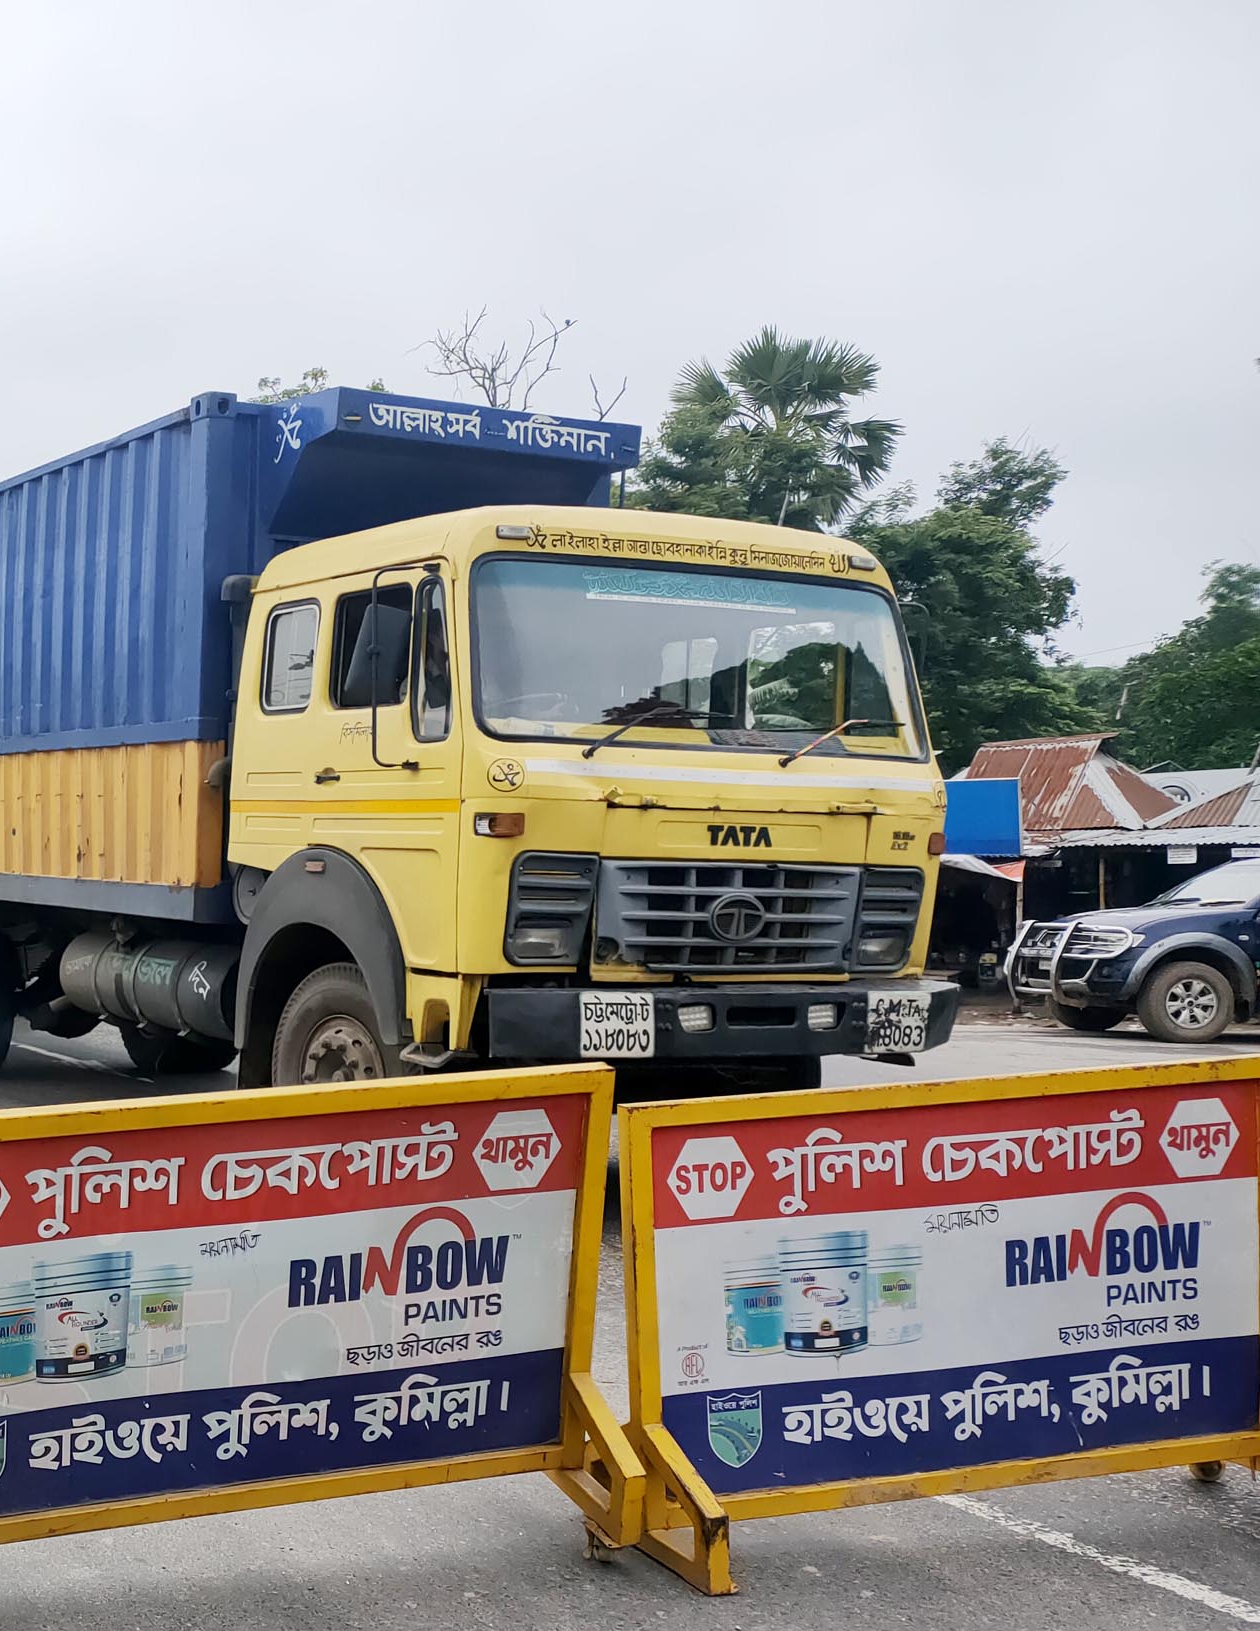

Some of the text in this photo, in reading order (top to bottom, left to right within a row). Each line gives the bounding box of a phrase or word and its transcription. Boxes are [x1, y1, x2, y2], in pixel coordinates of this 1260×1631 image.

[446, 409, 482, 440] সর্ব
[707, 825, 772, 847] TATA
[481, 1133, 553, 1171] থামুন
[1167, 1121, 1232, 1159] থামুন
[24, 1121, 460, 1238] পুলিশ চেকপোস্ট
[676, 1160, 746, 1196] STOP
[767, 1109, 1145, 1214] পুলিশ চেকপোস্ট
[288, 1206, 510, 1308] RAINBOW
[1006, 1192, 1201, 1287] RAINBOW
[403, 1293, 502, 1326] PAINTS
[1107, 1278, 1198, 1307] PAINTS
[346, 1330, 502, 1366] ছড়াও জীবনের রঙ
[1058, 1313, 1199, 1346] ছড়াও জীবনের রঙ
[782, 1391, 931, 1444] হাইওয়ে
[940, 1372, 1060, 1441] পুলিশ,
[29, 1413, 190, 1471] হাইওয়ে
[201, 1391, 338, 1460] পুলিশ,
